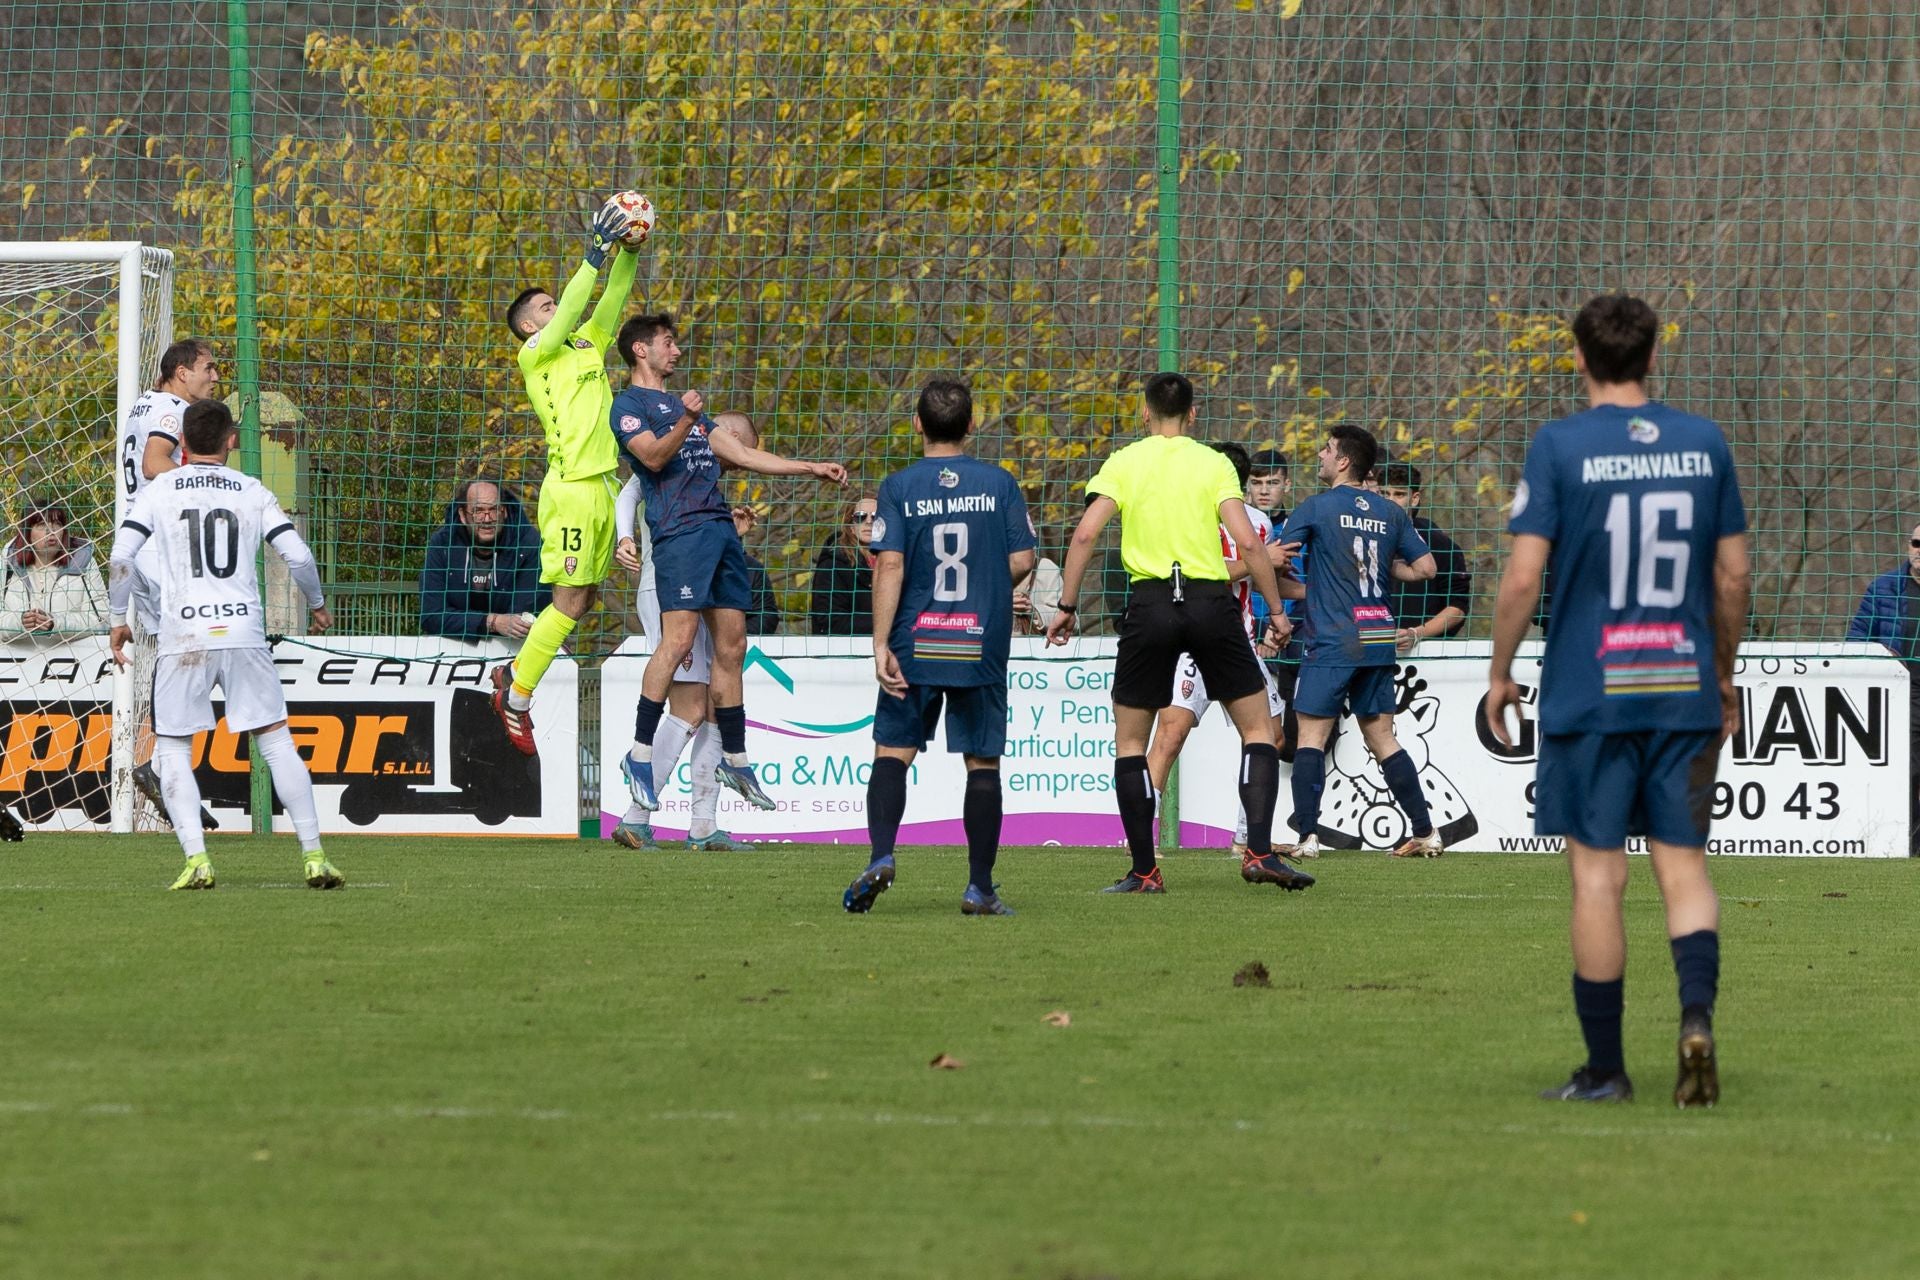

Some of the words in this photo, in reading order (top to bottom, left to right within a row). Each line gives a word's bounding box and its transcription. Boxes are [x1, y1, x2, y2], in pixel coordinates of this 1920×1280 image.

[122, 434, 138, 495] 6
[1582, 451, 1713, 484] ARECHAVALETA
[175, 476, 242, 491] BARRERO
[917, 499, 943, 517] SAN
[947, 493, 996, 514] MARTÍN
[1340, 514, 1387, 534] OLARTE
[179, 508, 239, 578] 10
[561, 527, 582, 551] 13
[1604, 491, 1693, 610] 16
[932, 522, 969, 602] 8
[1353, 535, 1383, 598] 11
[1008, 670, 1048, 690] ros
[1065, 665, 1117, 690] Gen
[1031, 706, 1044, 731] y
[1003, 732, 1116, 758] articulare
[383, 761, 432, 776] S.L.U.
[777, 800, 800, 812] DE
[811, 799, 863, 813] SEGU
[1783, 781, 1840, 820] 43
[1373, 815, 1390, 838] G
